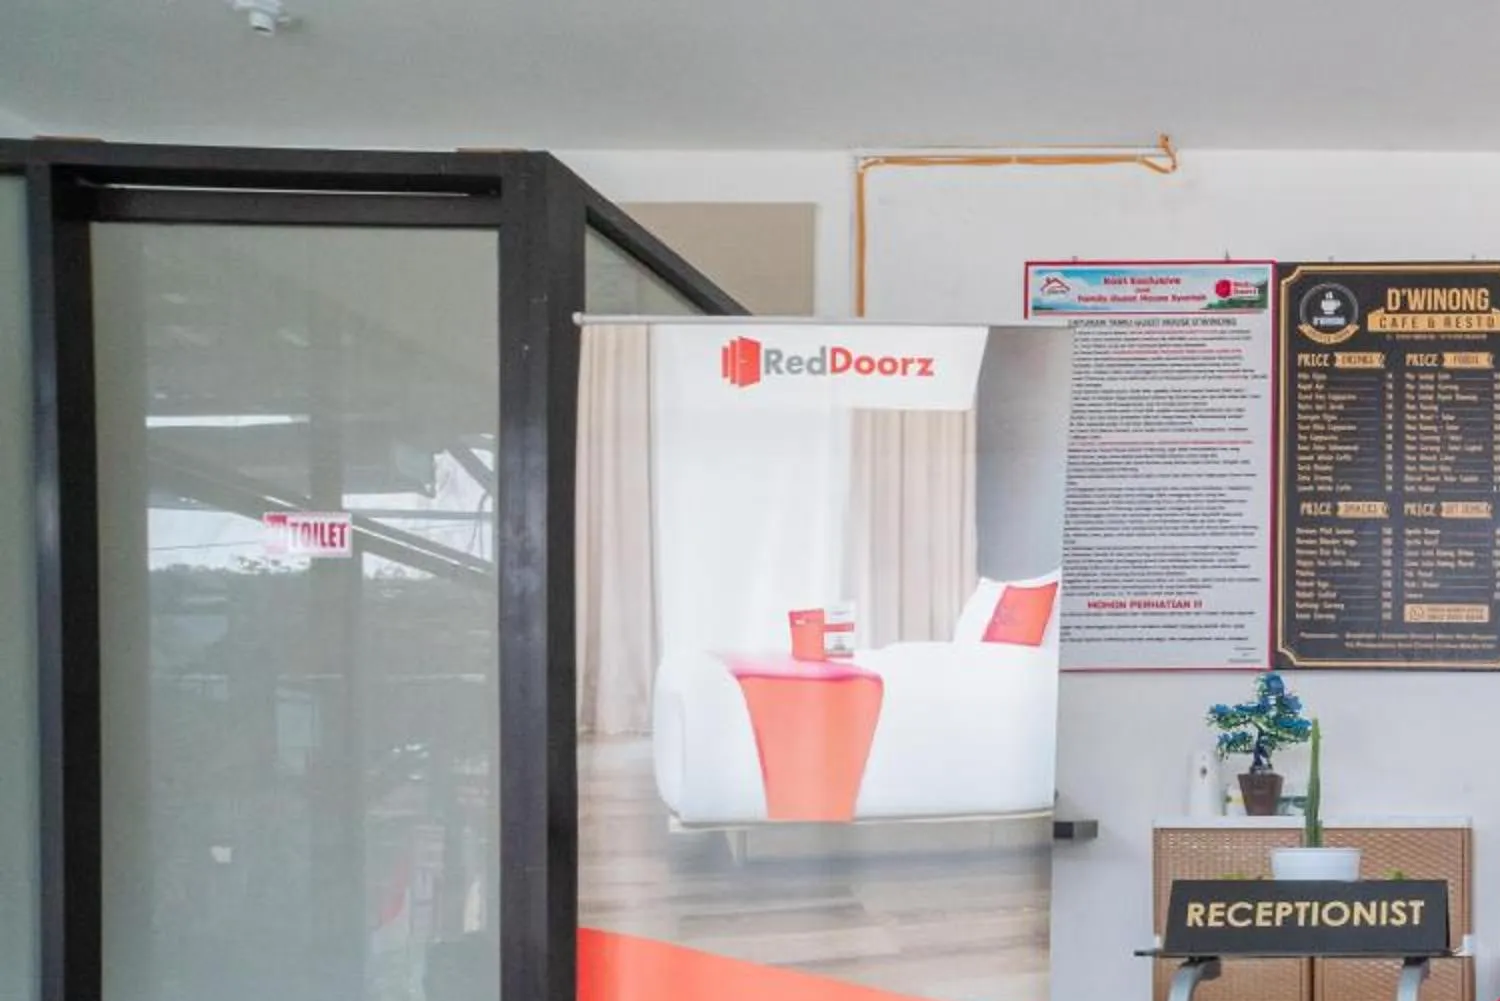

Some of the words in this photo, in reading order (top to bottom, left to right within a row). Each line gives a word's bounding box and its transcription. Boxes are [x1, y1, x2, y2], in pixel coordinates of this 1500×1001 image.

[1387, 287, 1490, 311] D'WINONG
[1379, 316, 1418, 329] CAFE
[1443, 315, 1496, 329] RESTO
[764, 345, 935, 378] RedDoorz
[288, 520, 348, 549] TOILET
[1185, 899, 1425, 928] RECEPTIONIST
